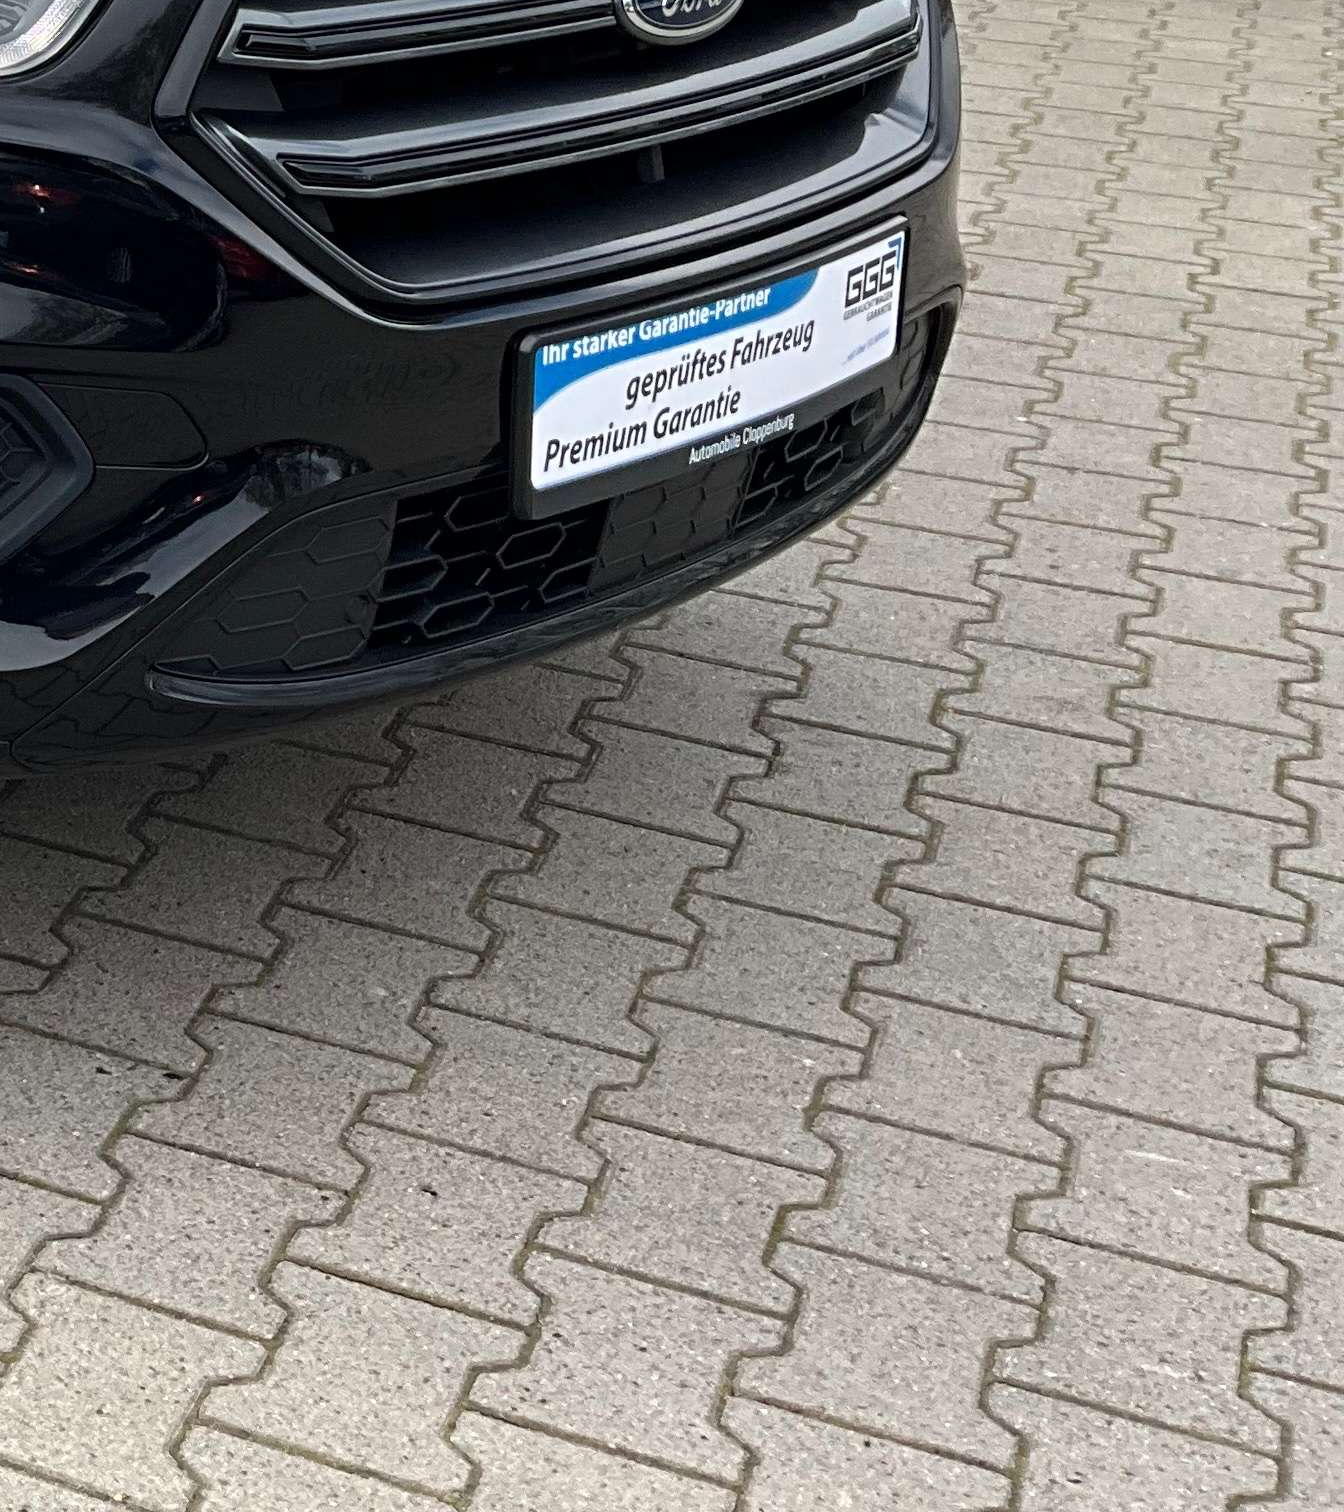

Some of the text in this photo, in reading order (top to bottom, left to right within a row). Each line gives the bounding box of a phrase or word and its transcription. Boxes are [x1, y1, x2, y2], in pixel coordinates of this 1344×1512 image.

[844, 249, 897, 308] GGG
[542, 287, 771, 366] Ihr starker Garantie-Partner
[625, 348, 727, 410] geprüftes
[730, 320, 815, 369] Fahrzeug
[544, 385, 741, 472] Premium Garantie
[689, 413, 795, 464] Automobile Cloppenburg
